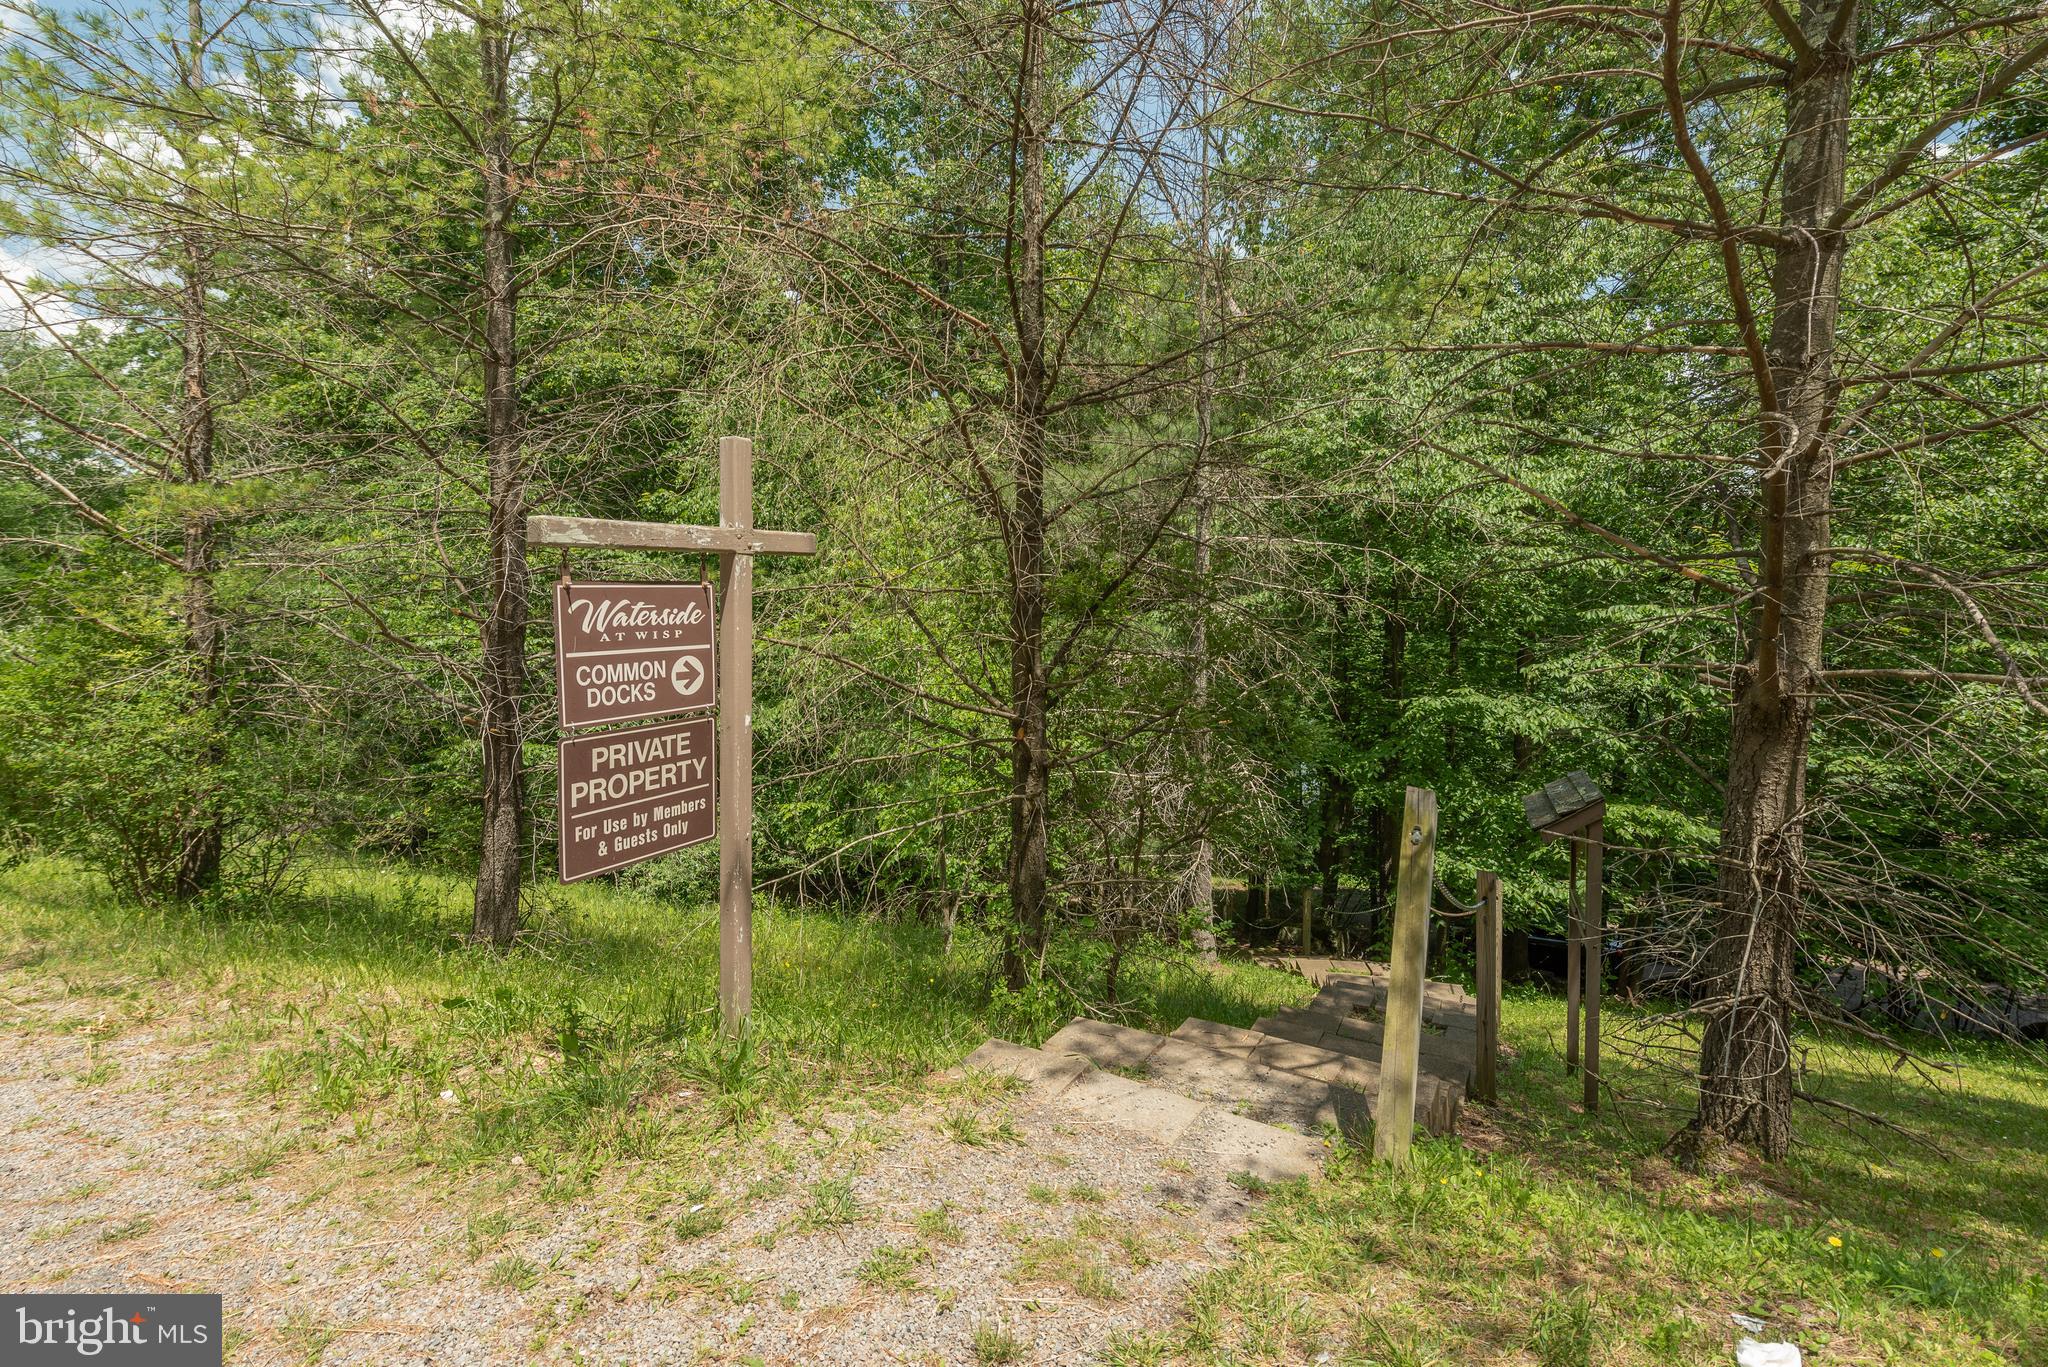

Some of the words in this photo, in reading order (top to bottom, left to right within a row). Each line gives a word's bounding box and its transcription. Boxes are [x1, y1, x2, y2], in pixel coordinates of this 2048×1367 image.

[568, 599, 705, 634] Waterside
[600, 632, 626, 642] AT
[635, 630, 683, 640] WISP
[576, 660, 666, 686] COMMON
[587, 682, 656, 708] DOCKS
[592, 732, 691, 772] PRIVATE
[571, 756, 707, 808] PROPERTY
[575, 825, 597, 843] For
[603, 818, 627, 835] Use
[633, 812, 648, 828] by
[653, 798, 706, 822] Members
[598, 841, 608, 856] &
[614, 829, 658, 852] Guests
[663, 820, 689, 838] Only
